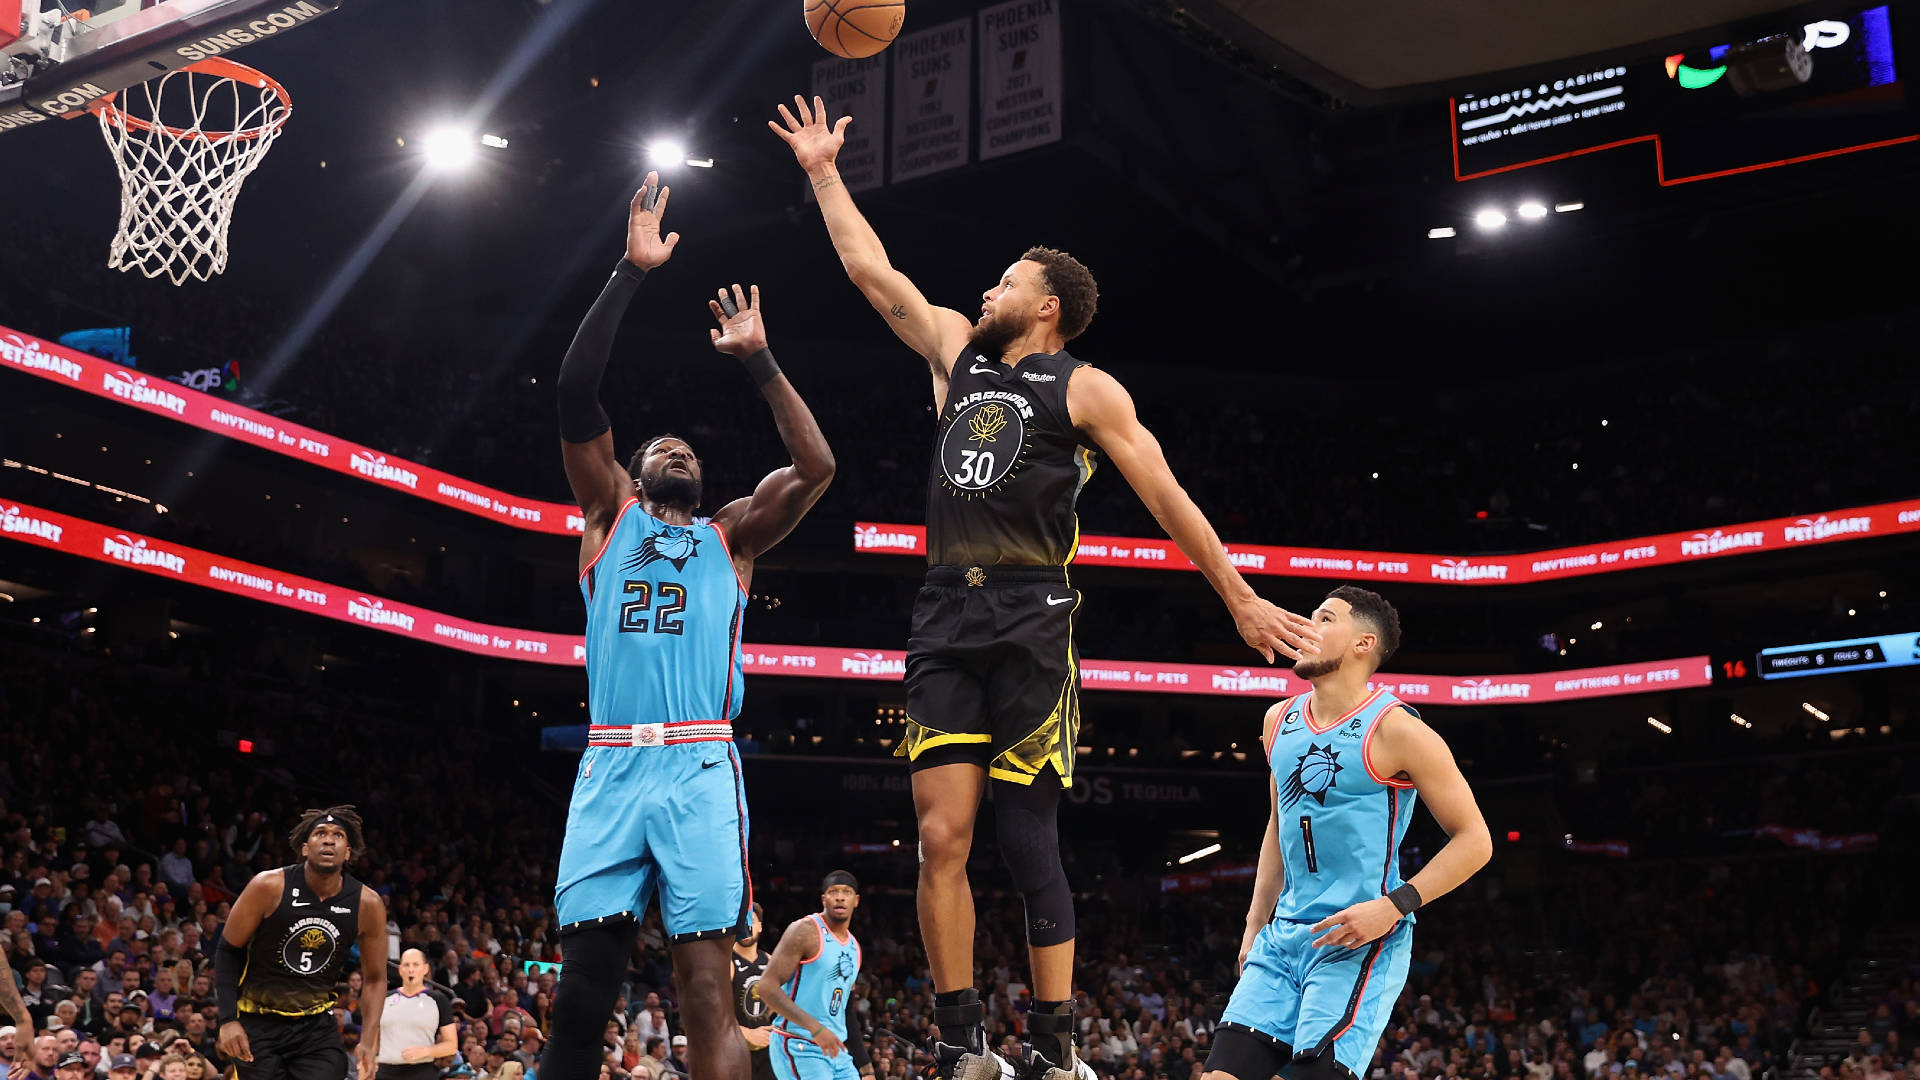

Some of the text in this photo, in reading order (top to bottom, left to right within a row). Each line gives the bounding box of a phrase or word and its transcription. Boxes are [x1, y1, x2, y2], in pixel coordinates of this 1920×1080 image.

[985, 0, 1053, 32] PHOENIX
[176, 2, 321, 62] SUNS.COM
[899, 24, 967, 61] PHOENIX
[999, 24, 1039, 51] SUNS
[911, 52, 952, 79] SUNS
[1458, 88, 1532, 113] RESORTS
[1553, 66, 1627, 91] CASINOS
[1022, 371, 1056, 383] Rakuten
[104, 372, 187, 415] PETSMART
[954, 390, 1034, 419] WARRIORS
[210, 409, 329, 457] ANYTHING for PETS
[350, 453, 418, 489] PETSMART
[955, 449, 995, 486] 30
[438, 482, 541, 522] ANYTHING for PETS
[0, 514, 63, 543] SMART
[854, 532, 917, 550] TSMART
[1784, 516, 1871, 542] PETSMART
[103, 537, 186, 574] PETSMART
[1111, 546, 1130, 558] for
[1133, 547, 1166, 560] PETS
[1681, 531, 1764, 556] PETSMART
[1289, 556, 1409, 574] ANYTHING for PETS
[1430, 563, 1508, 580] PETSMART
[1532, 545, 1657, 573] ANYTHING for PETS
[209, 566, 327, 606] ANYTHING for PETS
[347, 600, 415, 631] PETSMART
[618, 579, 687, 636] 22
[434, 623, 548, 653] ANYTHING for PETS
[758, 653, 778, 666] for
[782, 655, 817, 668] PETS
[842, 657, 907, 675] PETSMA
[1722, 660, 1747, 679] 16
[1134, 671, 1153, 682] for
[1157, 672, 1188, 684] PETS
[1211, 675, 1288, 692] PETSMART
[1399, 683, 1430, 695] PETS
[1555, 668, 1680, 692] ANYTHING for PETS
[1452, 683, 1531, 700] PETSMART
[1122, 783, 1201, 803] TEQUILA
[1300, 815, 1318, 873] 1
[300, 951, 313, 972] 5
[829, 987, 843, 1017] 0
